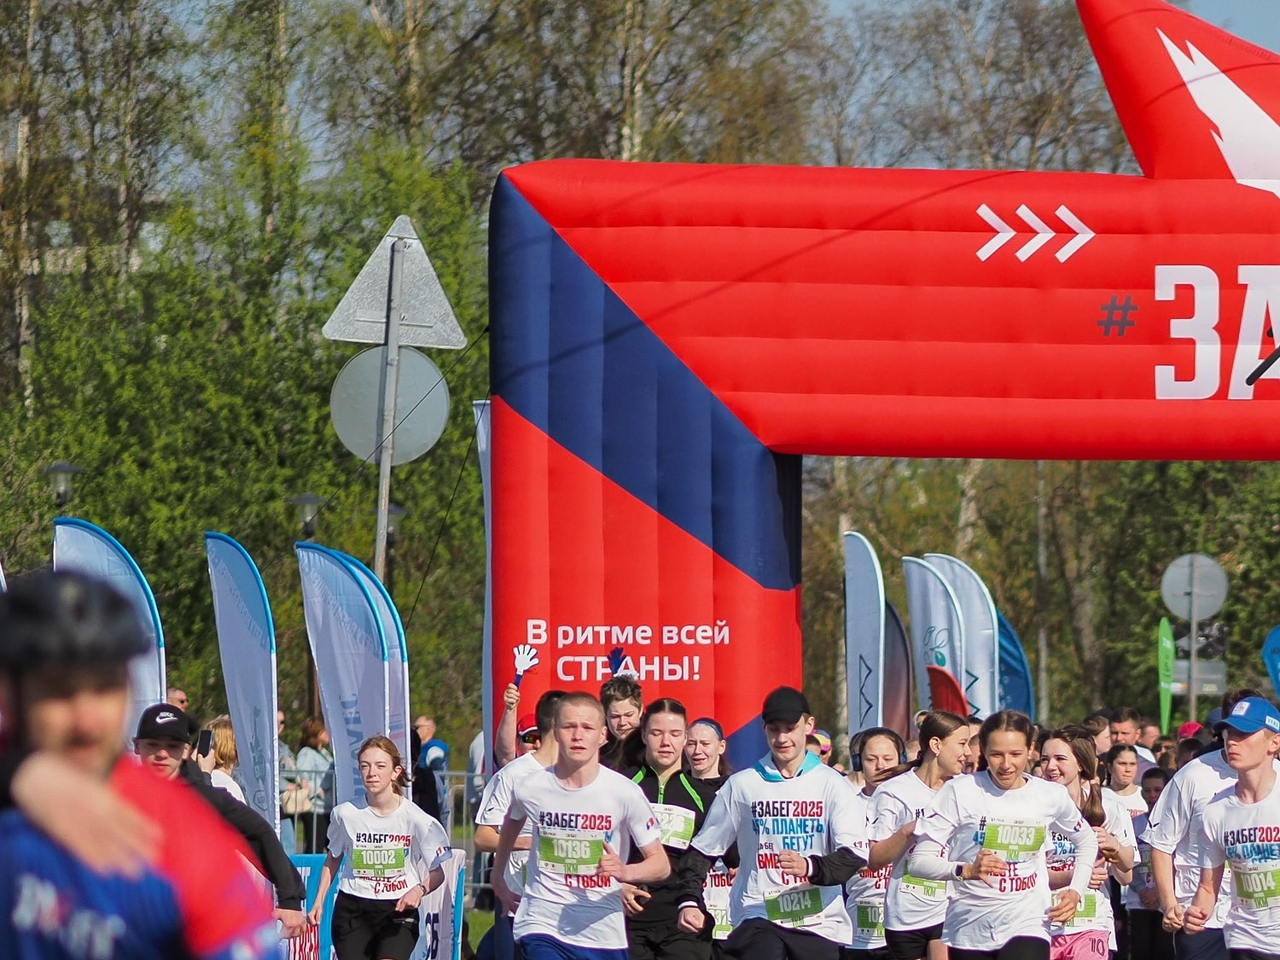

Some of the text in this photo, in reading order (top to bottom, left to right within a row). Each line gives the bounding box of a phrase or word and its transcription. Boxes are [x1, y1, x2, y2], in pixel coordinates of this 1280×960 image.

[526, 618, 730, 648] В ритме всей
[556, 655, 700, 681] СТРАНЫ!
[751, 800, 824, 818] #ЗАБЕГ2025
[539, 811, 612, 831] #ЗАБЕГ2025
[782, 834, 815, 851] БЕГУТ
[997, 825, 1036, 846] 10033
[361, 849, 396, 865] 10002
[552, 838, 591, 859] 10136
[1241, 871, 1276, 892] 10014
[777, 890, 812, 913] 10214
[866, 906, 885, 923] 102
